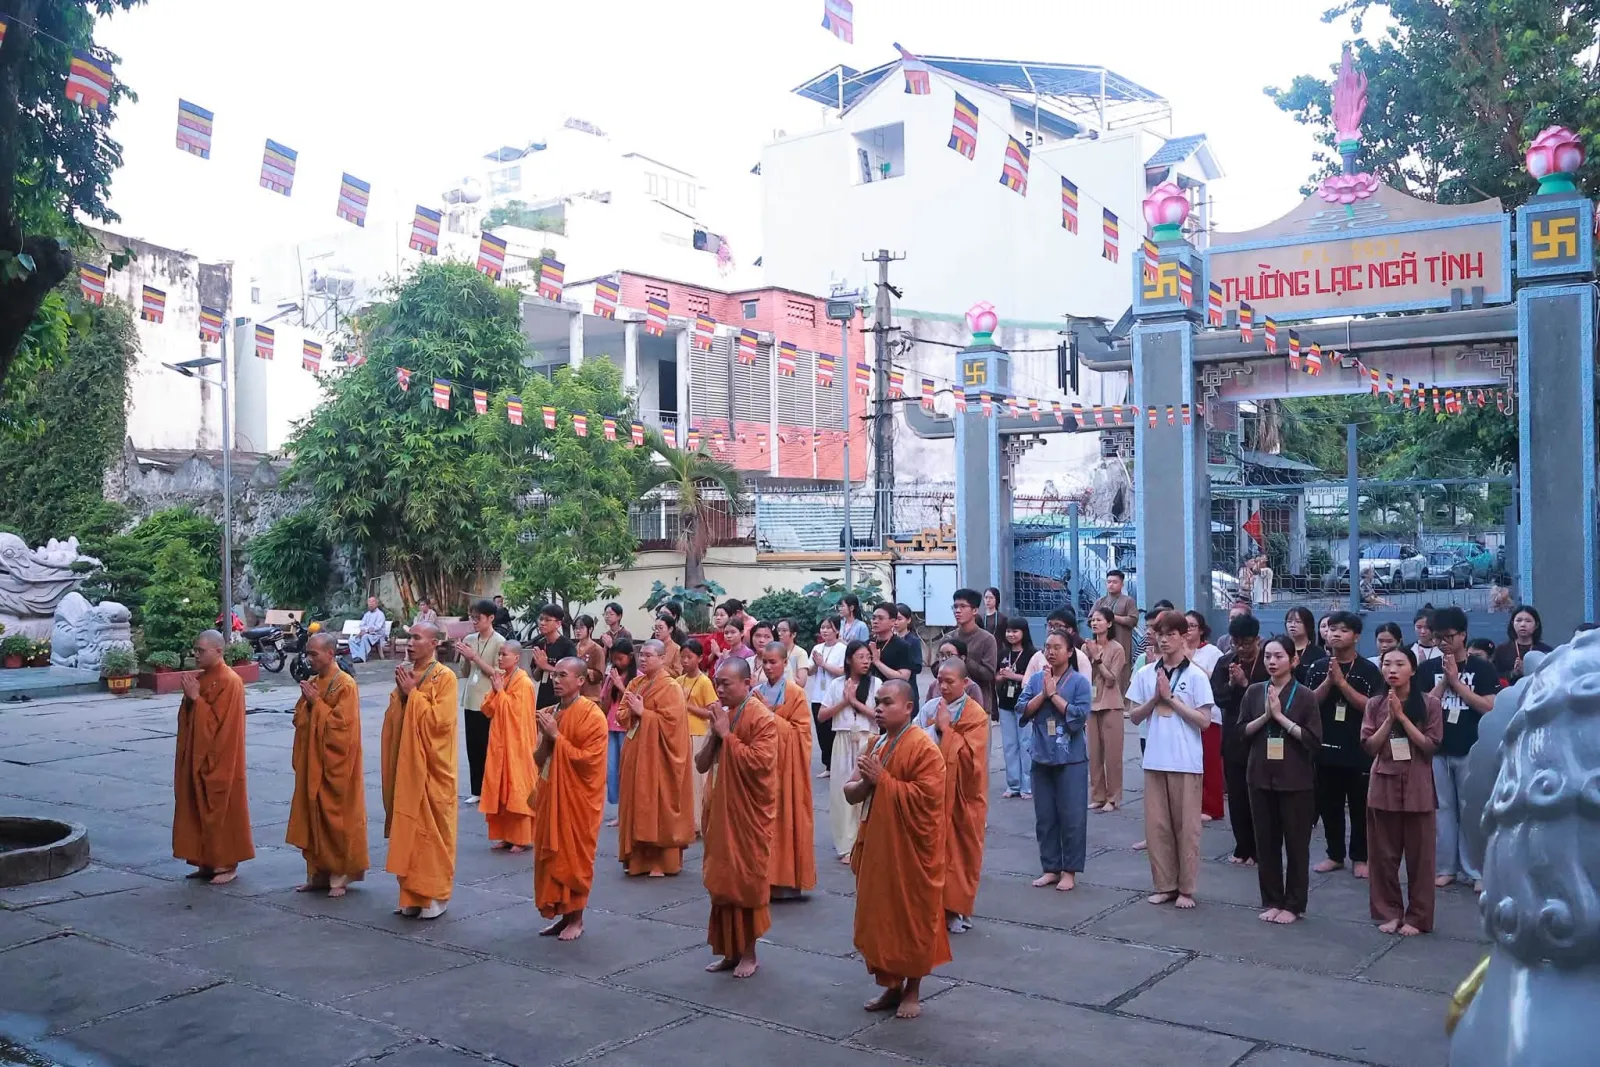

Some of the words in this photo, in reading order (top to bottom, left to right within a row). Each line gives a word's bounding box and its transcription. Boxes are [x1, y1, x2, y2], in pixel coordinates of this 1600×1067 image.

[1221, 263, 1309, 302] THƯỜNG
[1315, 264, 1363, 296] LẠC
[1368, 251, 1417, 289] NGÃ
[1424, 251, 1483, 286] TỊNH
